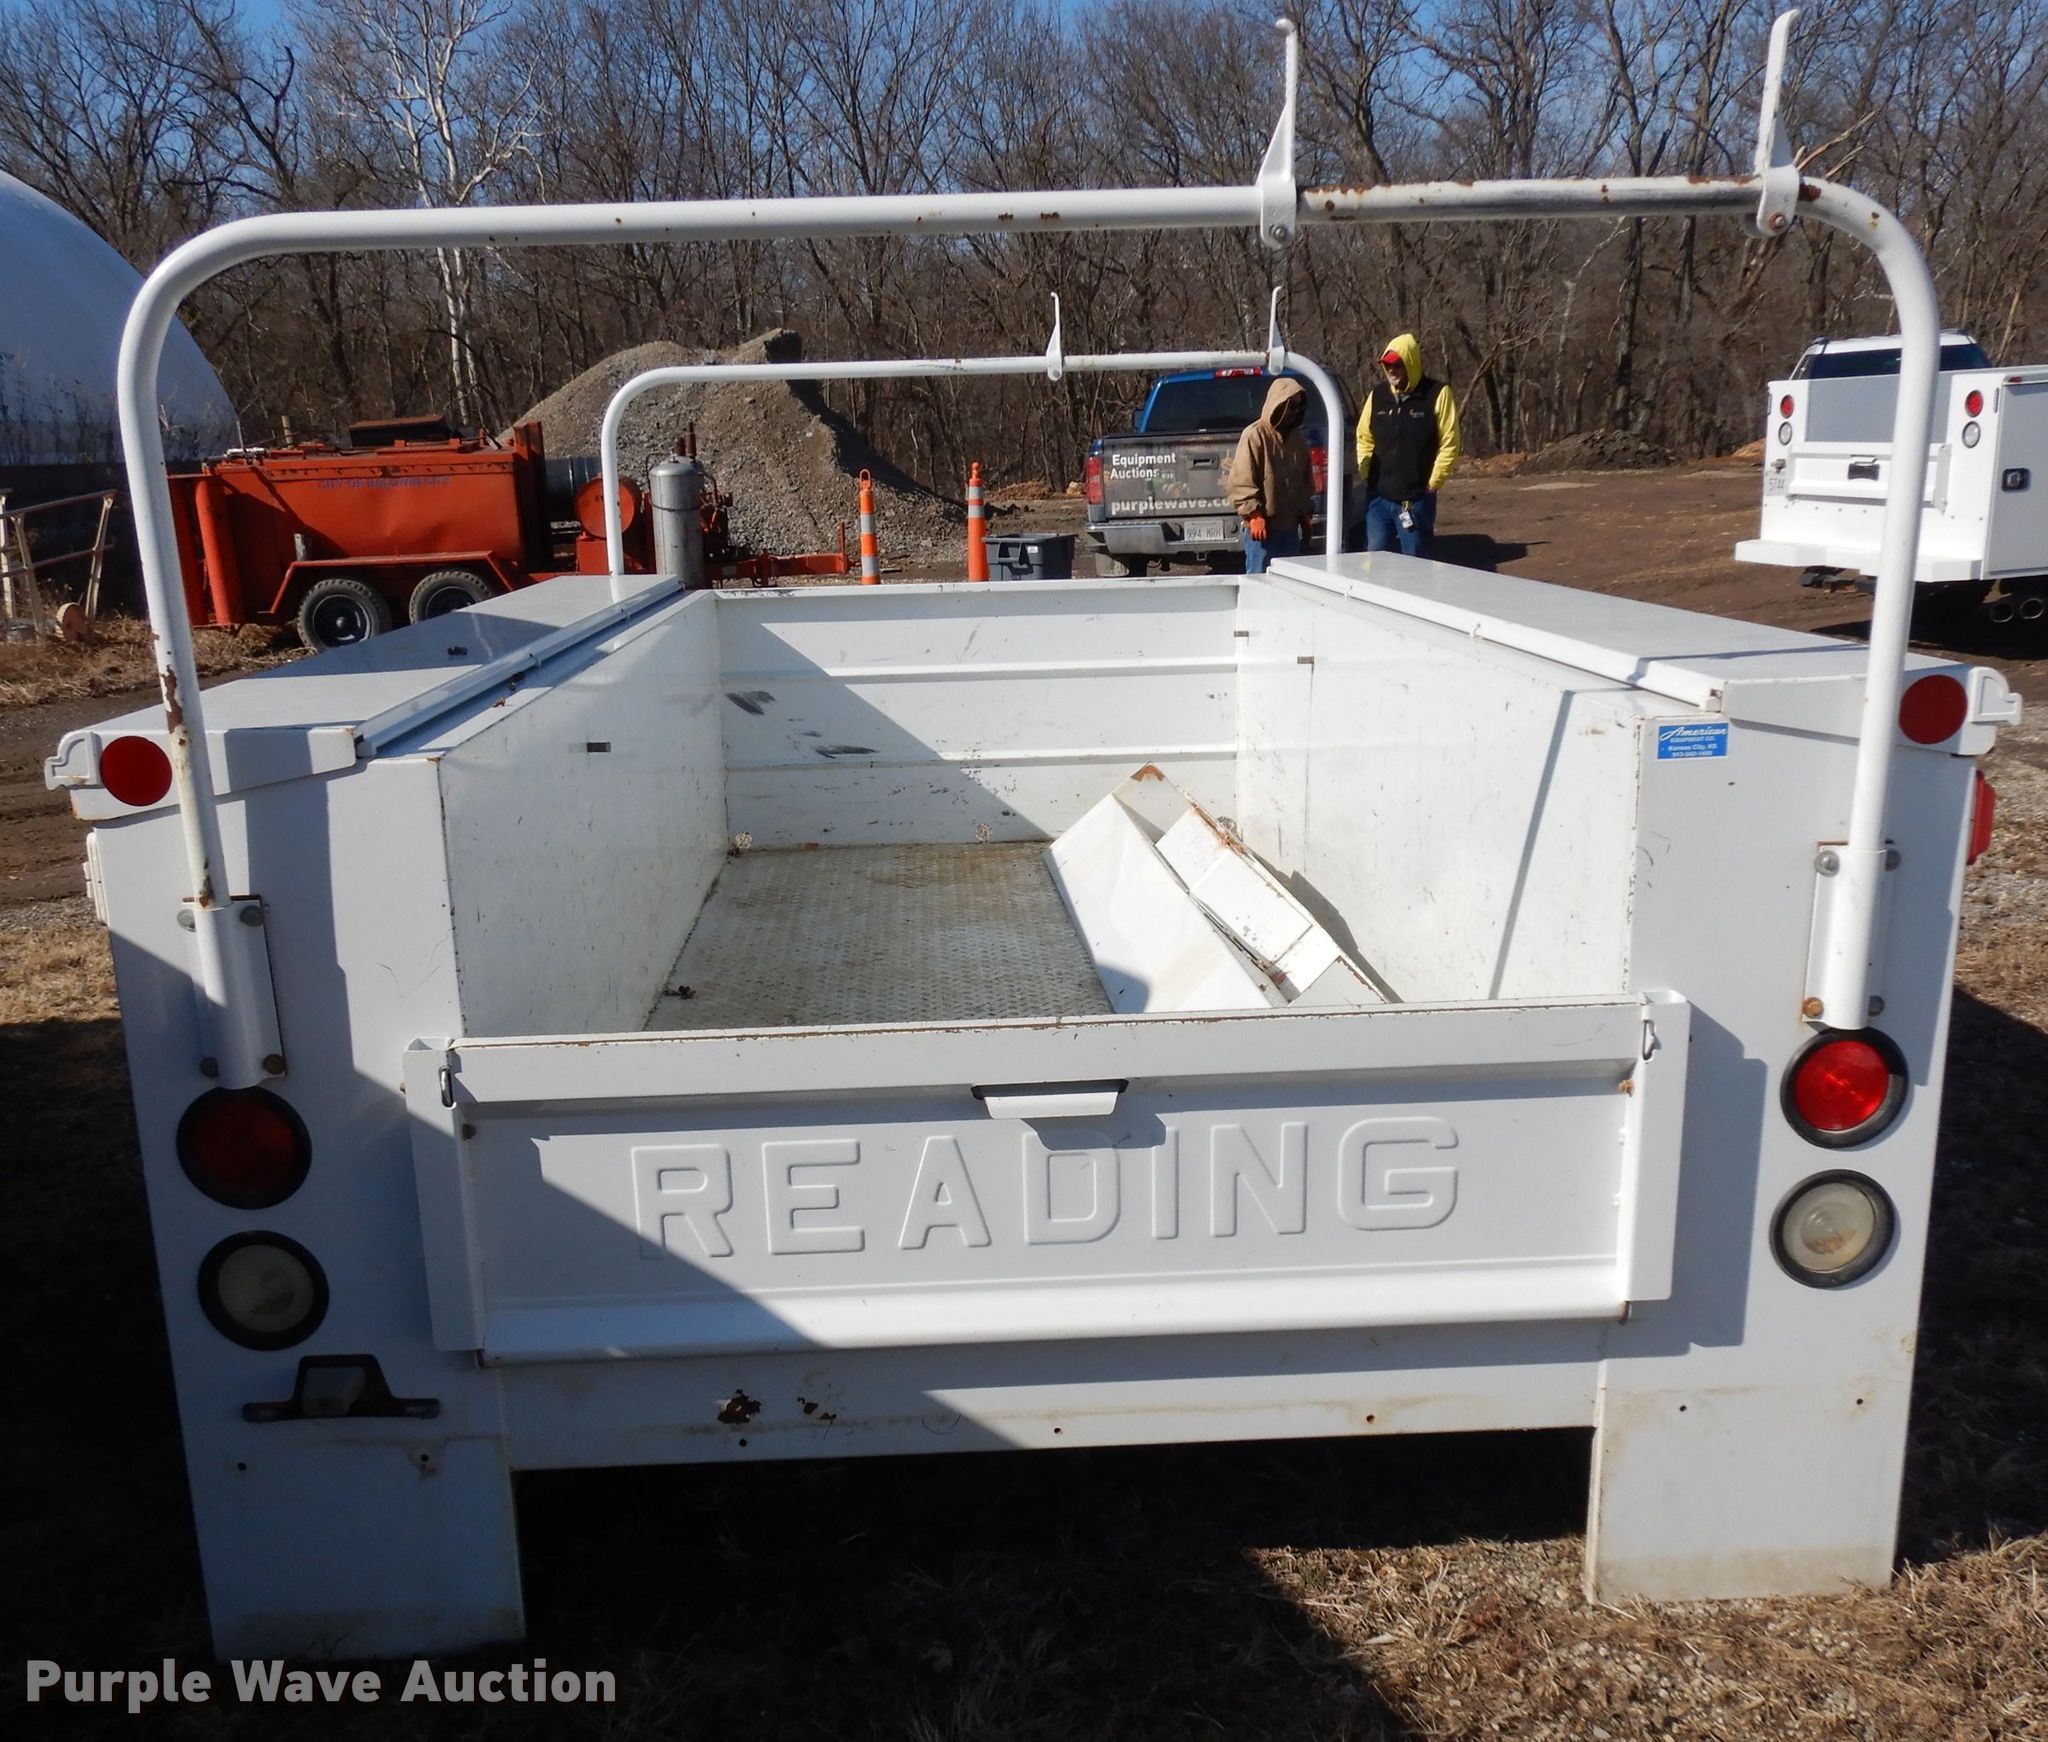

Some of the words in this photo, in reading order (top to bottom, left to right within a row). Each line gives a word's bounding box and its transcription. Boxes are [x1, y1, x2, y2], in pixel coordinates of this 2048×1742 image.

[1112, 452, 1176, 466] Equipment
[1110, 466, 1159, 480] Auctions
[1111, 496, 1230, 515] purplewave.co
[1660, 726, 1727, 741] American
[630, 1115, 1460, 1262] READING
